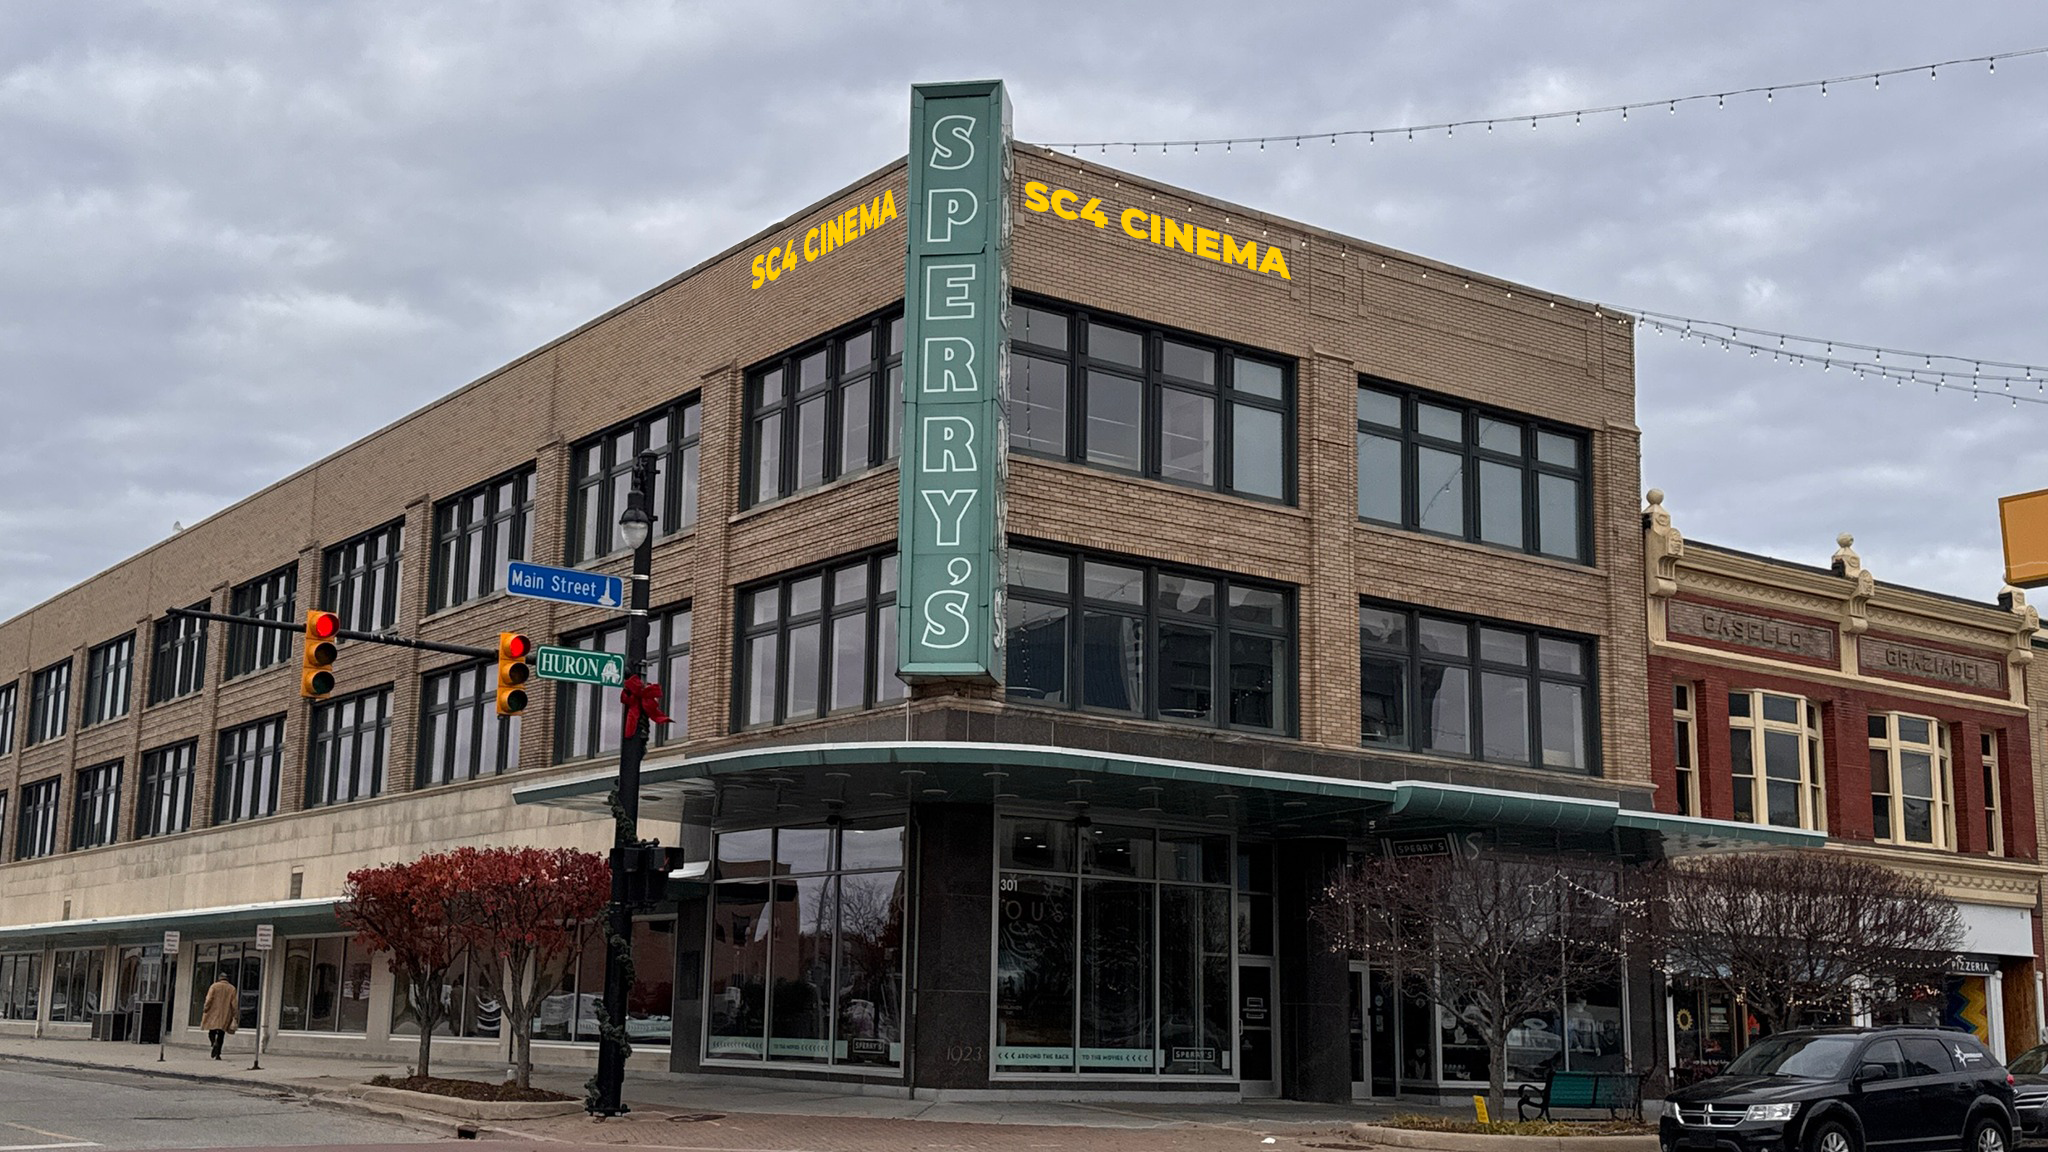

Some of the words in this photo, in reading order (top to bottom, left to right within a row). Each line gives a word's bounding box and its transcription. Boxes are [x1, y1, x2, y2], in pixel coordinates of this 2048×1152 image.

[751, 238, 798, 290] SC4
[803, 189, 898, 263] CINEMA
[1024, 181, 1109, 229] SC4
[1120, 208, 1292, 280] CINEMA
[511, 569, 545, 590] Main
[551, 575, 597, 597] Street
[541, 652, 600, 678] HURON
[1885, 647, 1980, 682] GRAZIADEI
[1397, 842, 1445, 854] SPERRY'S
[1000, 878, 1018, 892] 301
[1951, 960, 1990, 973] PIZZERIA
[946, 1046, 983, 1065] 1923
